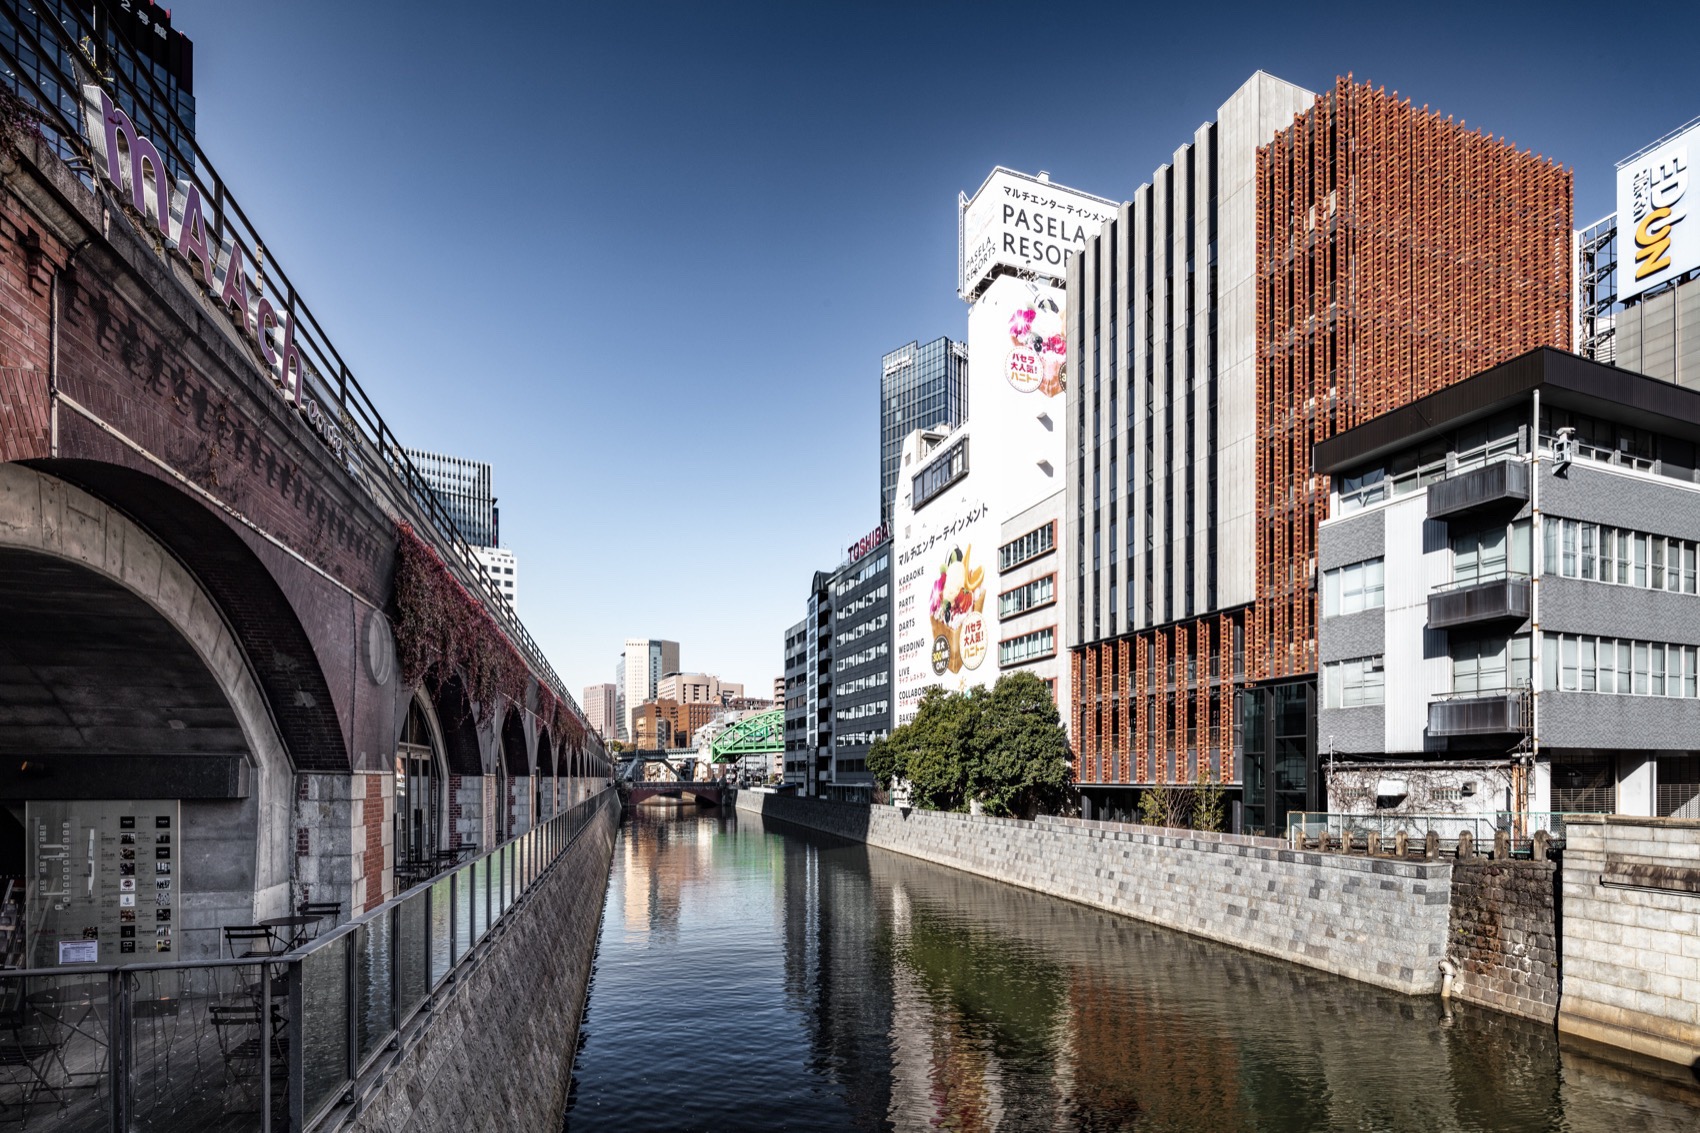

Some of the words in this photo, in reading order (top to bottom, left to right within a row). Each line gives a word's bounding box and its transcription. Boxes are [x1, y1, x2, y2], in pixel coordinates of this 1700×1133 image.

[1003, 204, 1087, 245] PASELA
[966, 236, 991, 270] PASELA
[848, 521, 889, 564] TOSHIBA
[898, 566, 924, 587] KARAOKE
[898, 594, 915, 610] PARTY
[898, 618, 916, 632] DARTS
[898, 637, 925, 655] WEDDING
[898, 667, 910, 678] LIVE
[898, 712, 917, 723] BAKER
